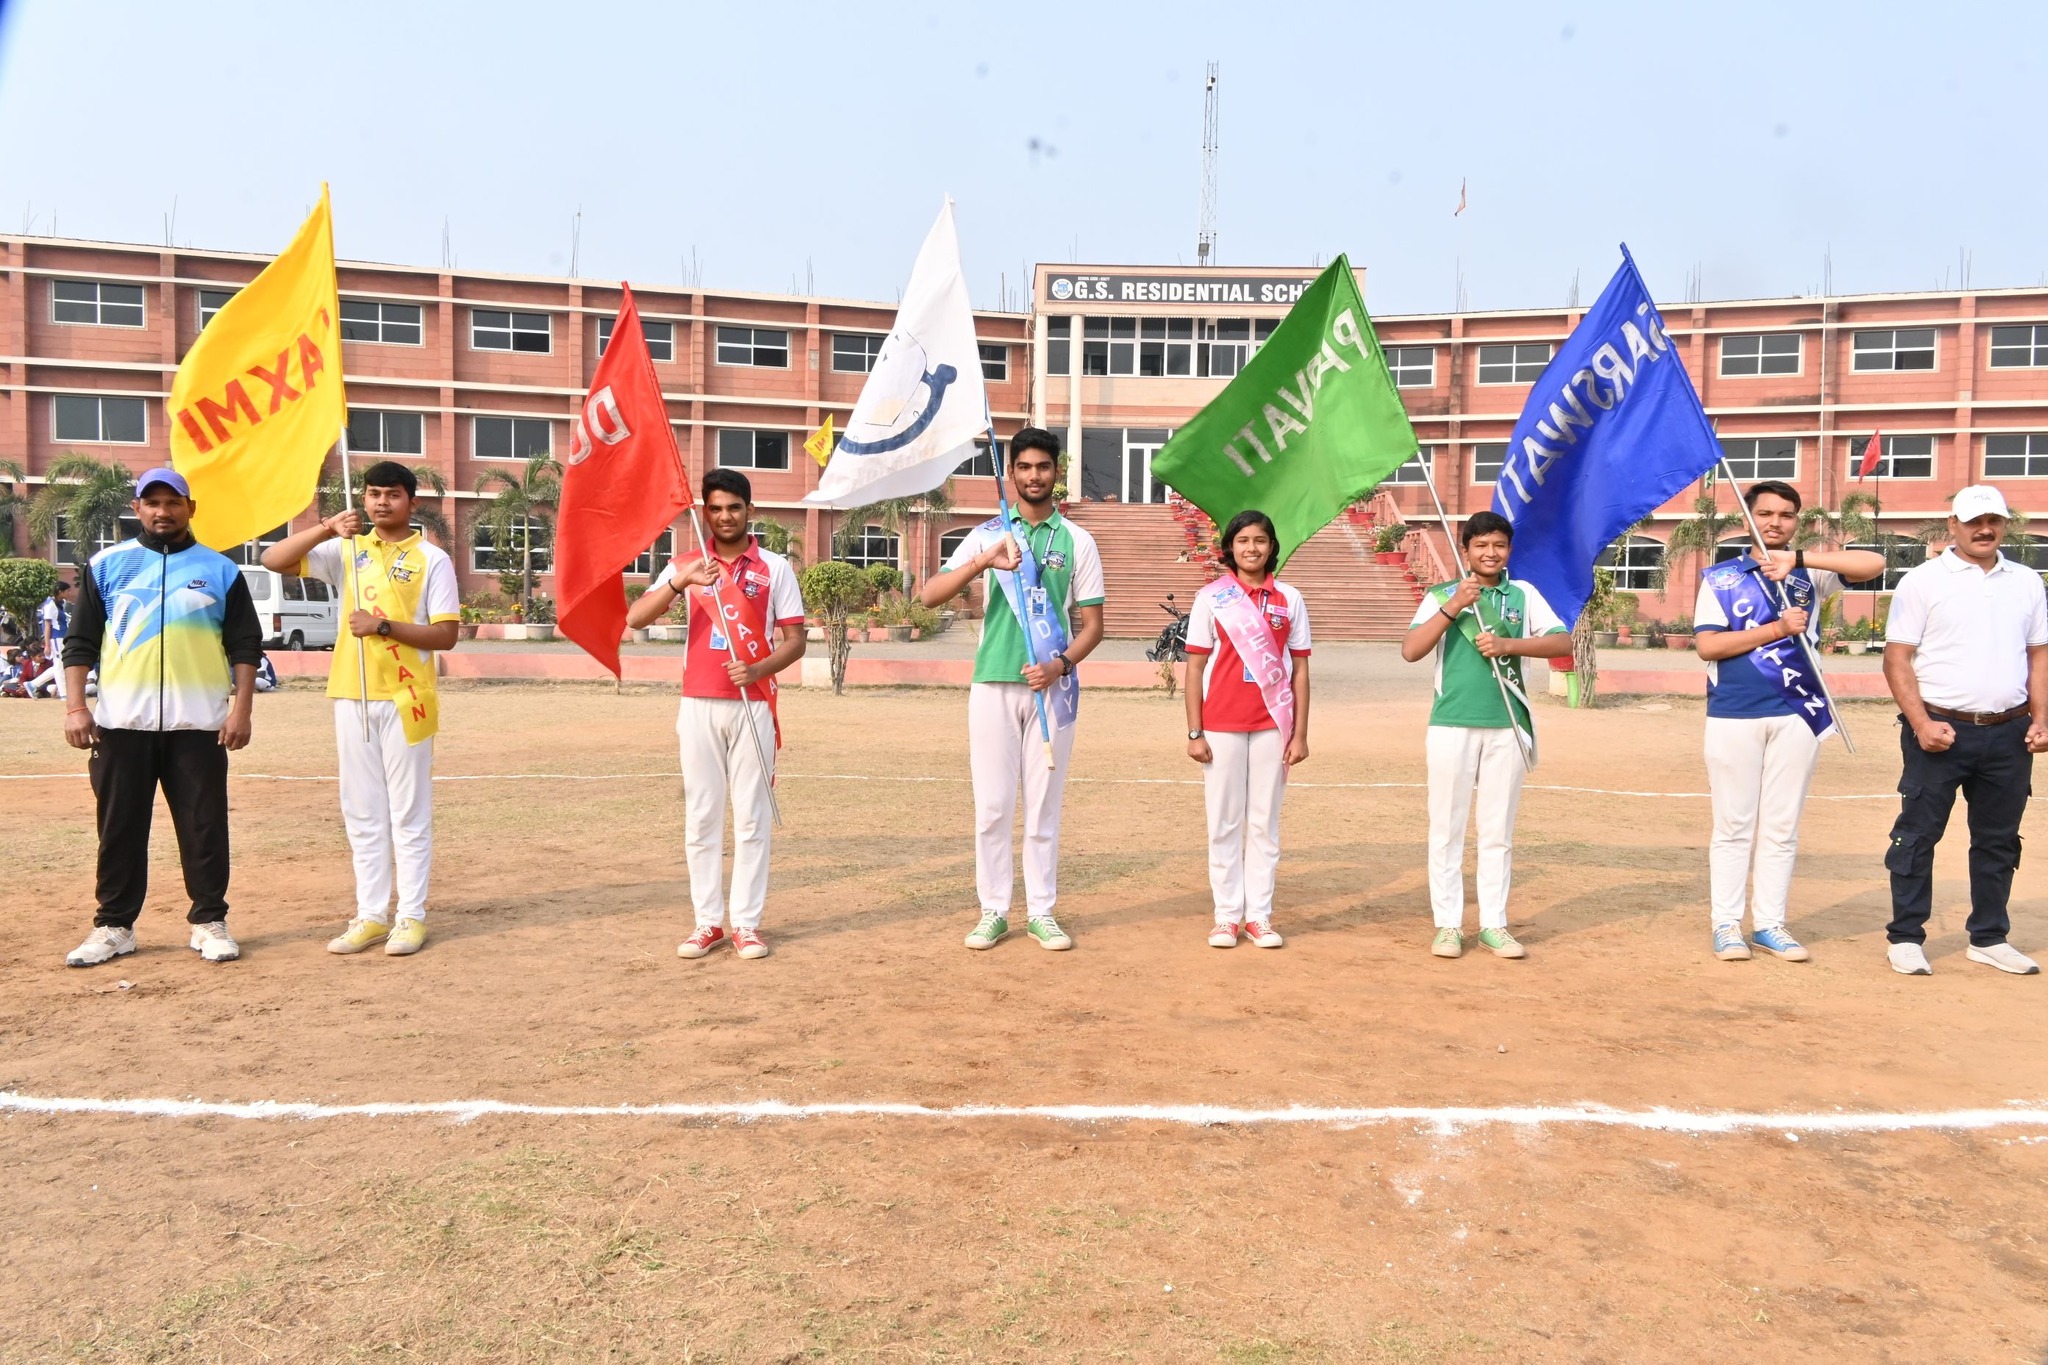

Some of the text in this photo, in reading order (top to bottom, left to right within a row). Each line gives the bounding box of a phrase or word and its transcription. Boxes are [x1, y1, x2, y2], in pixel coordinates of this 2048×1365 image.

[1075, 281, 1311, 302] G.S. RESIDENTIAL SCH
[191, 579, 207, 587] NIKE
[364, 585, 426, 722] CATAIN
[1237, 617, 1284, 686] HEAD
[1732, 598, 1825, 717] CATAIN
